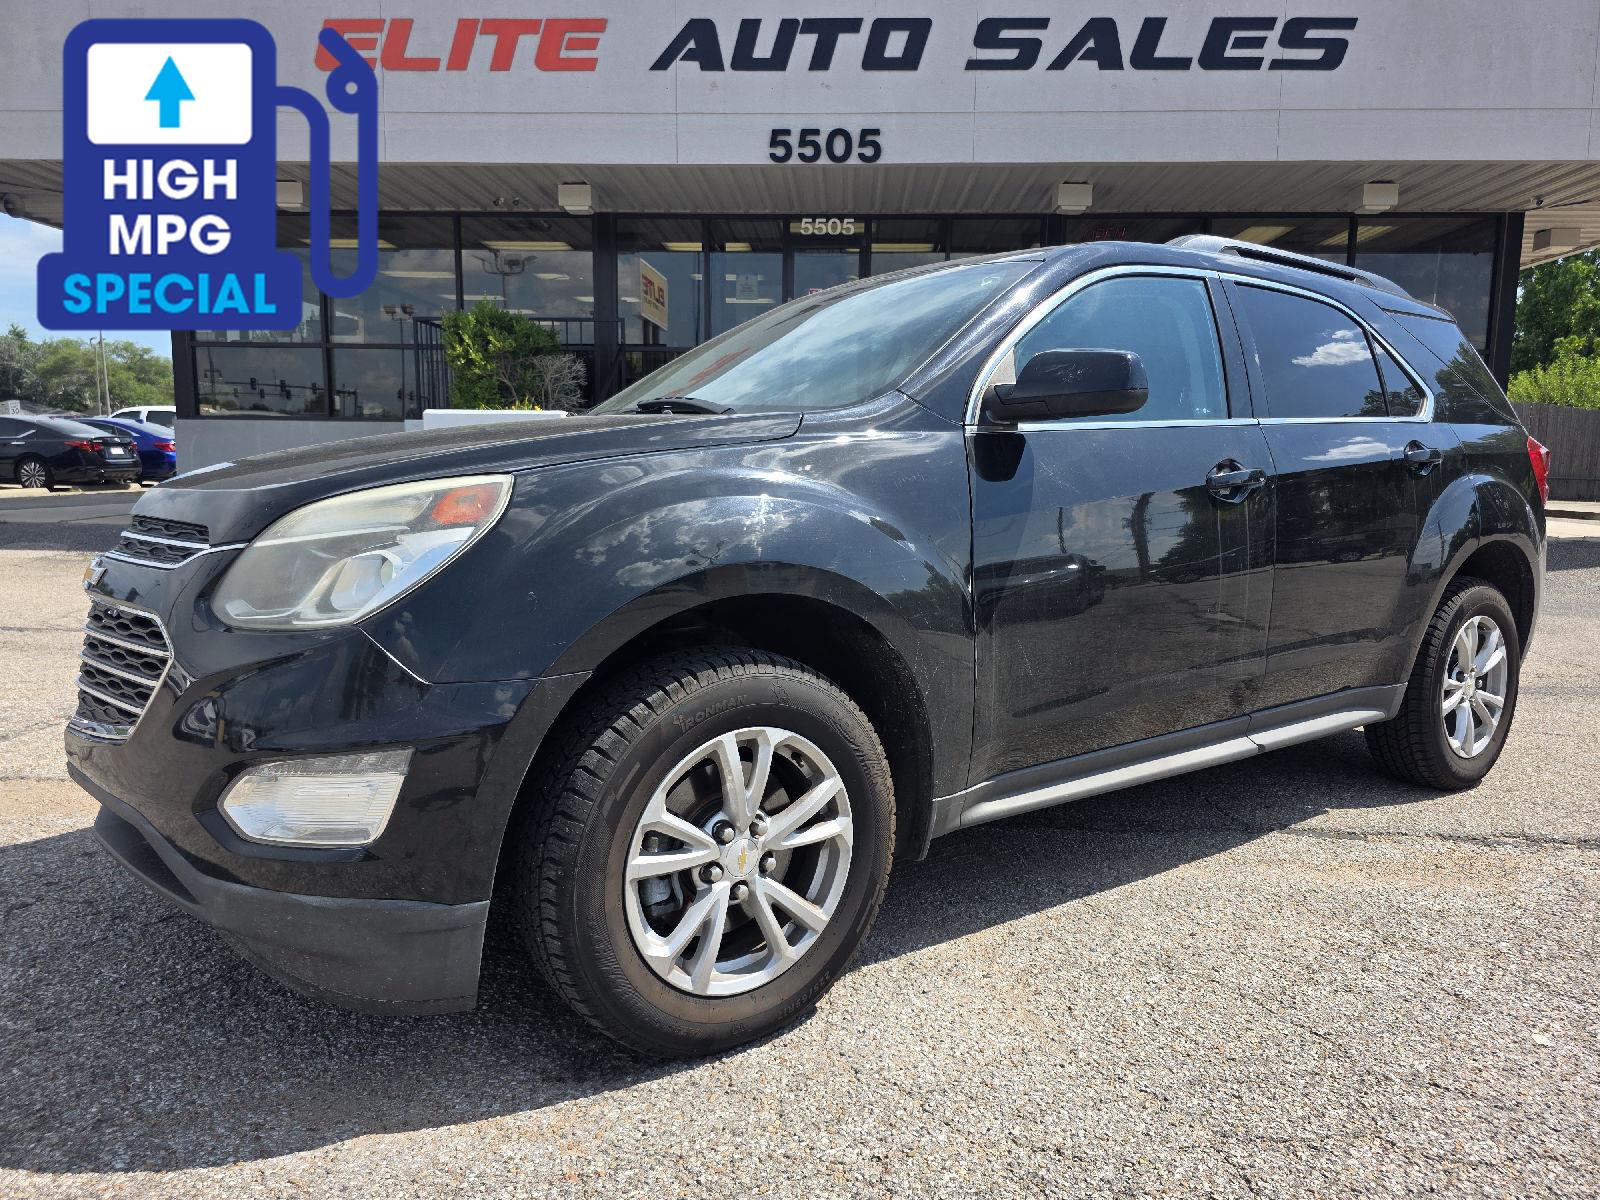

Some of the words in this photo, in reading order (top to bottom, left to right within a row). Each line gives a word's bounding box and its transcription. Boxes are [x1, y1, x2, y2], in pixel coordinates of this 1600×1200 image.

[314, 18, 608, 72] ELITE
[650, 17, 932, 72] AUTO
[964, 17, 1358, 71] SALES
[769, 128, 882, 163] 5505
[800, 218, 855, 236] 5505
